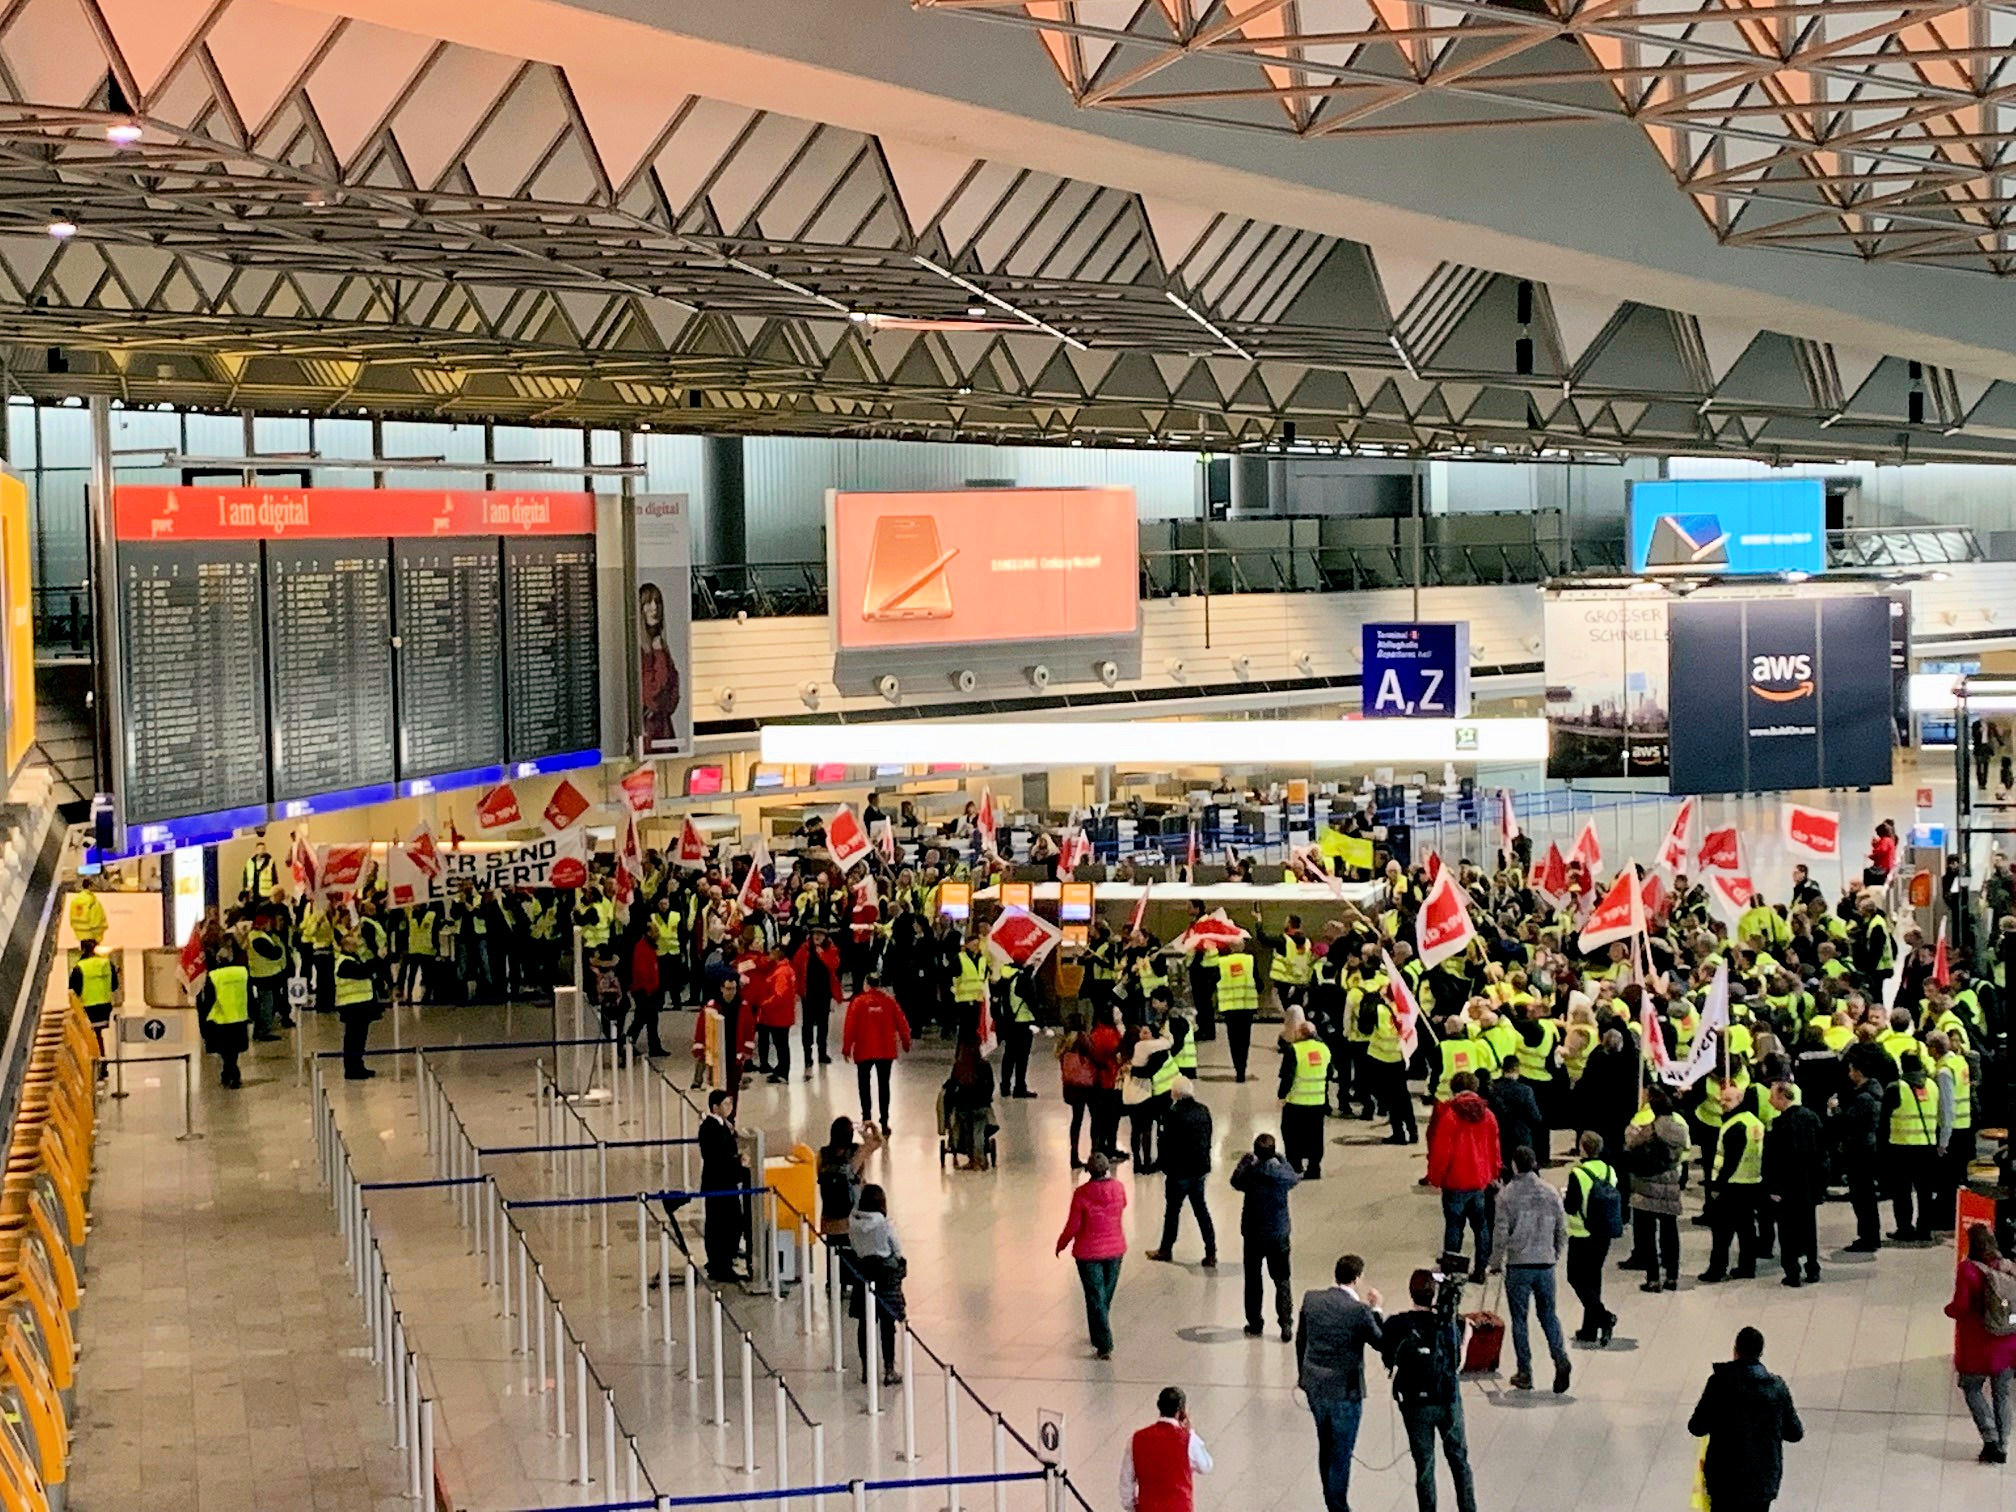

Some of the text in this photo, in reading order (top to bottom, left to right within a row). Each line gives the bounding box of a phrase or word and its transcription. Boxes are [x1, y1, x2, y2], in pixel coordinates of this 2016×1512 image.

[218, 494, 309, 533] I am digital
[482, 497, 550, 530] I am digital
[645, 502, 680, 518] digital
[1376, 630, 1408, 639] Terminal
[1752, 654, 1812, 682] aws
[1632, 745, 1660, 757] aws
[485, 839, 556, 870] SIND
[472, 861, 551, 893] WERT
